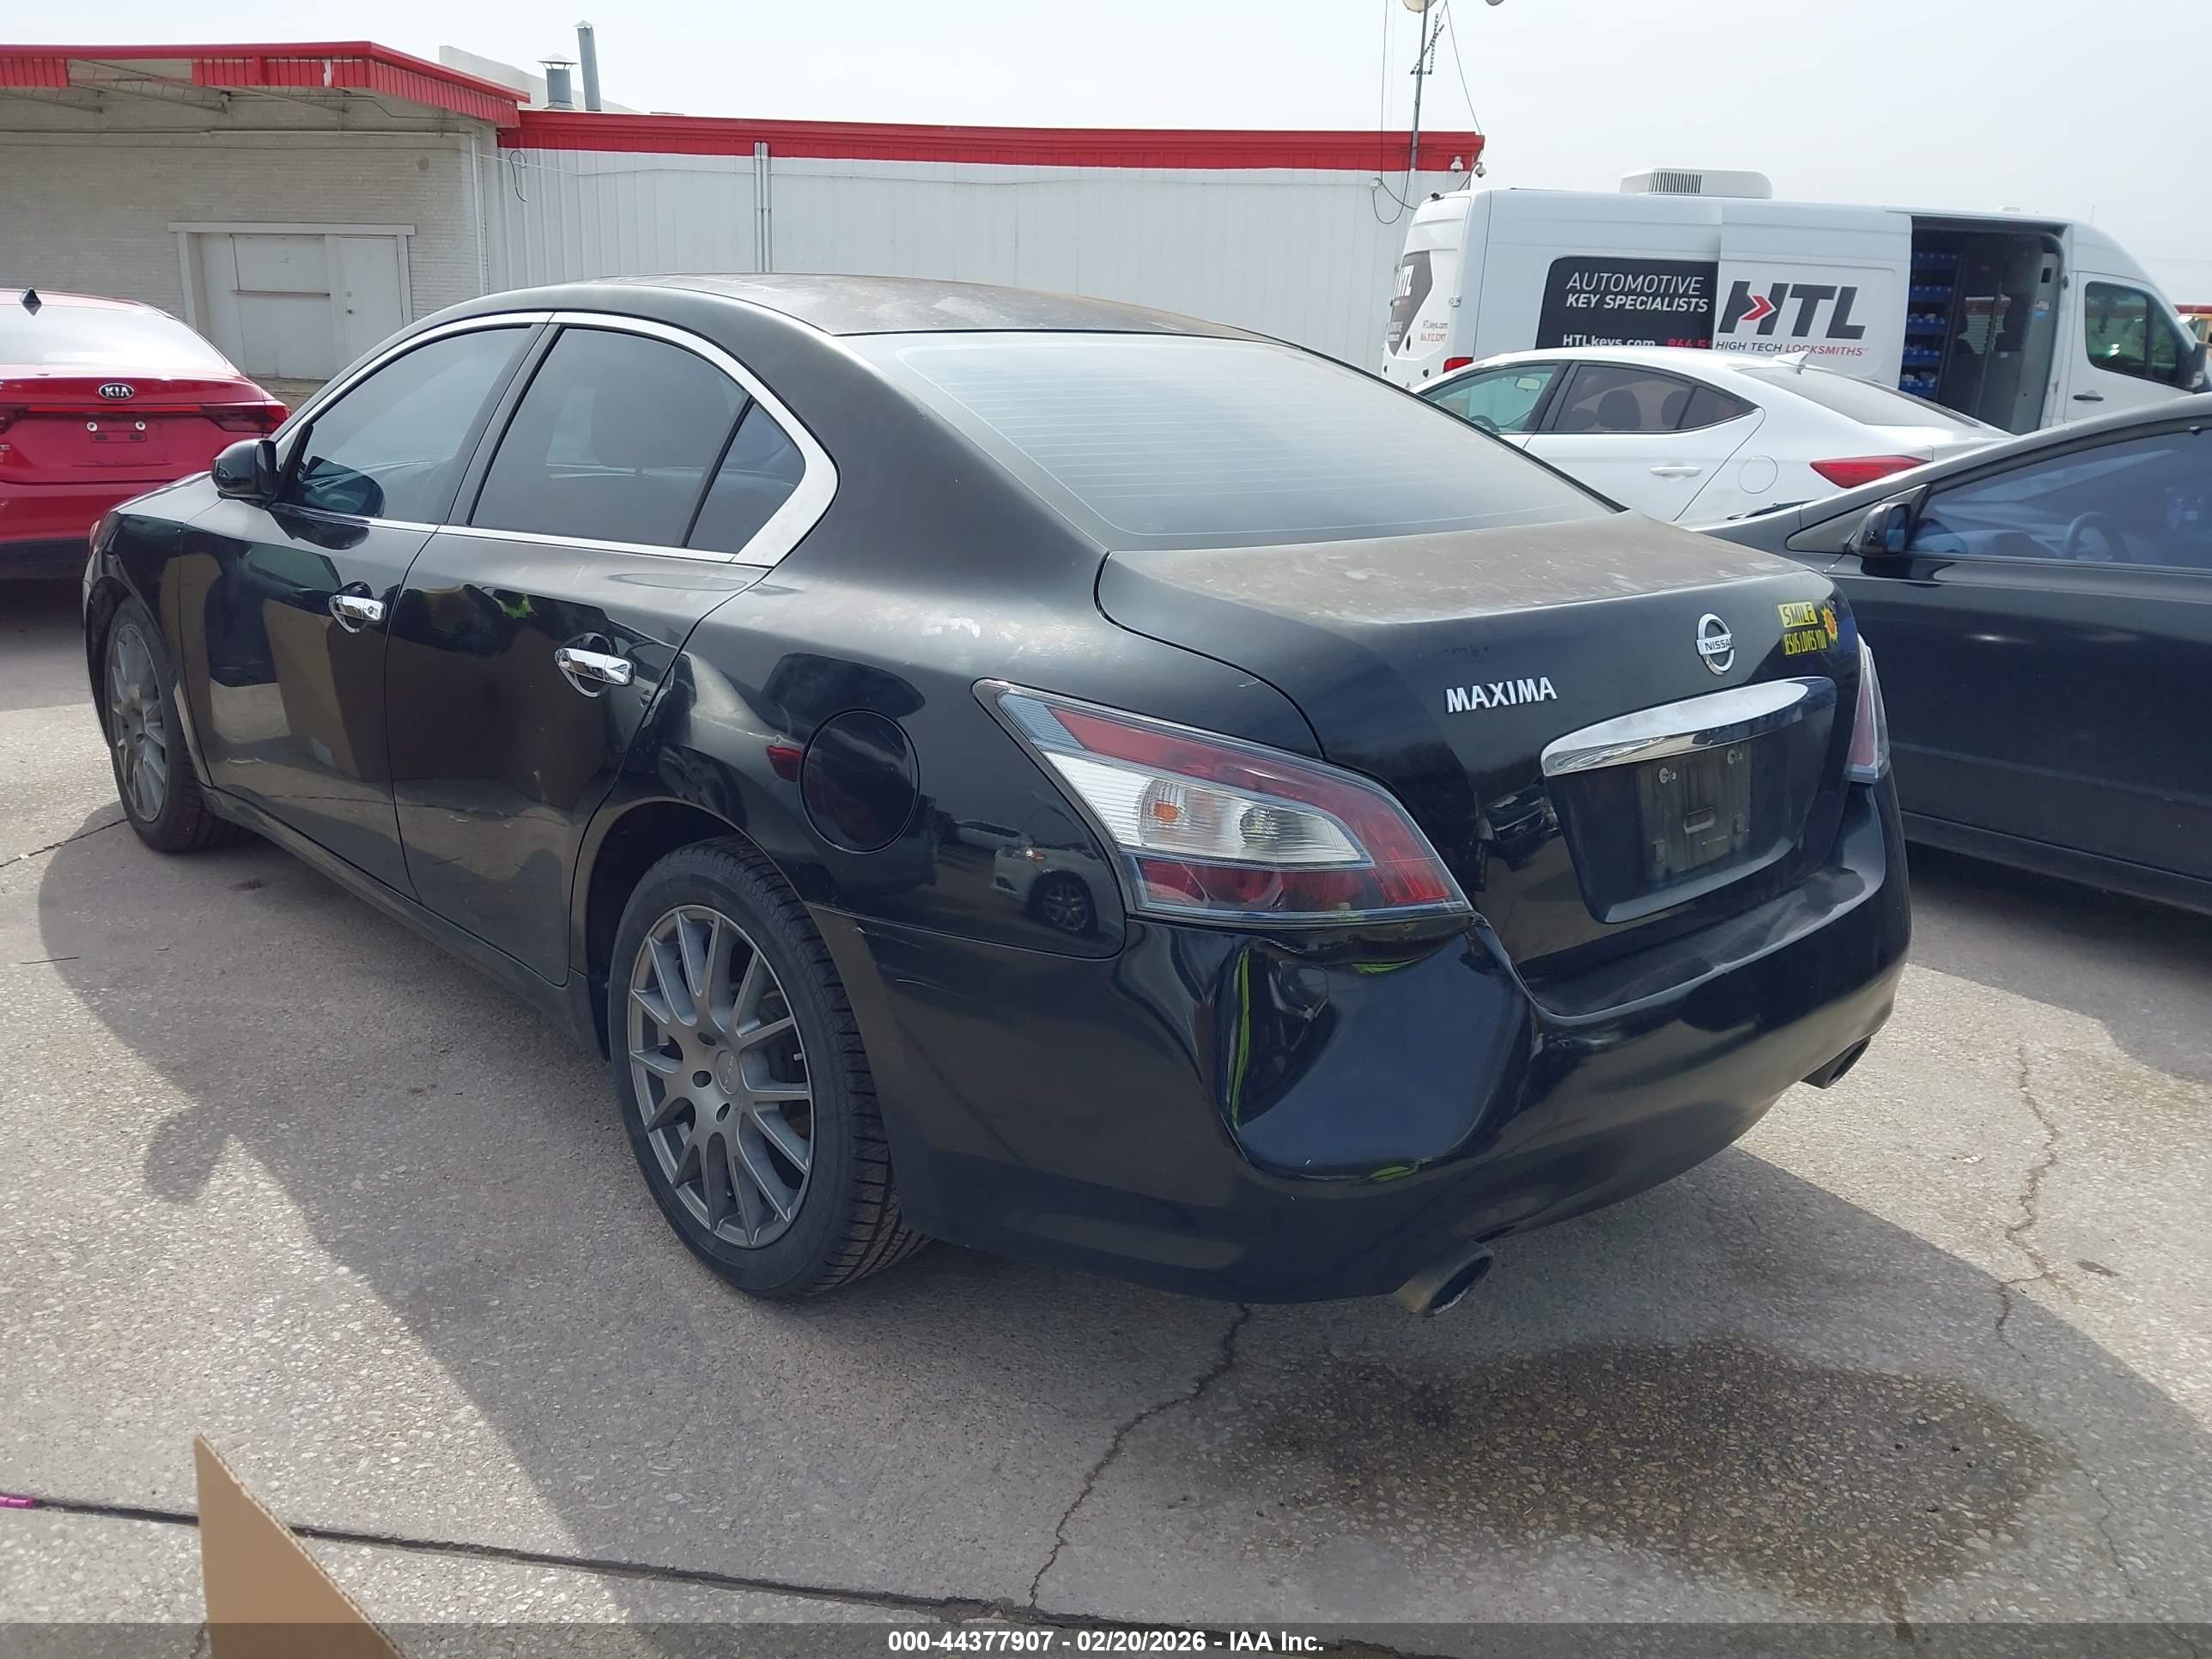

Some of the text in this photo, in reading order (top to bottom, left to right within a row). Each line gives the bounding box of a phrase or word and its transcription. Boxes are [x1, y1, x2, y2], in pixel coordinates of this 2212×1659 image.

[1565, 271, 1705, 295] AUTOMOTIVE
[1565, 293, 1710, 313] KEY SPECIALISTS
[1717, 280, 1866, 340] HTL
[1562, 333, 1656, 347] HTLkeyscom
[1716, 340, 1863, 356] HIGH TECH LOCKSMITHS
[105, 386, 131, 397] KIA
[1782, 604, 1814, 626] SMILE
[1705, 637, 1732, 652] NISSA
[1446, 676, 1558, 714] MAXIMA
